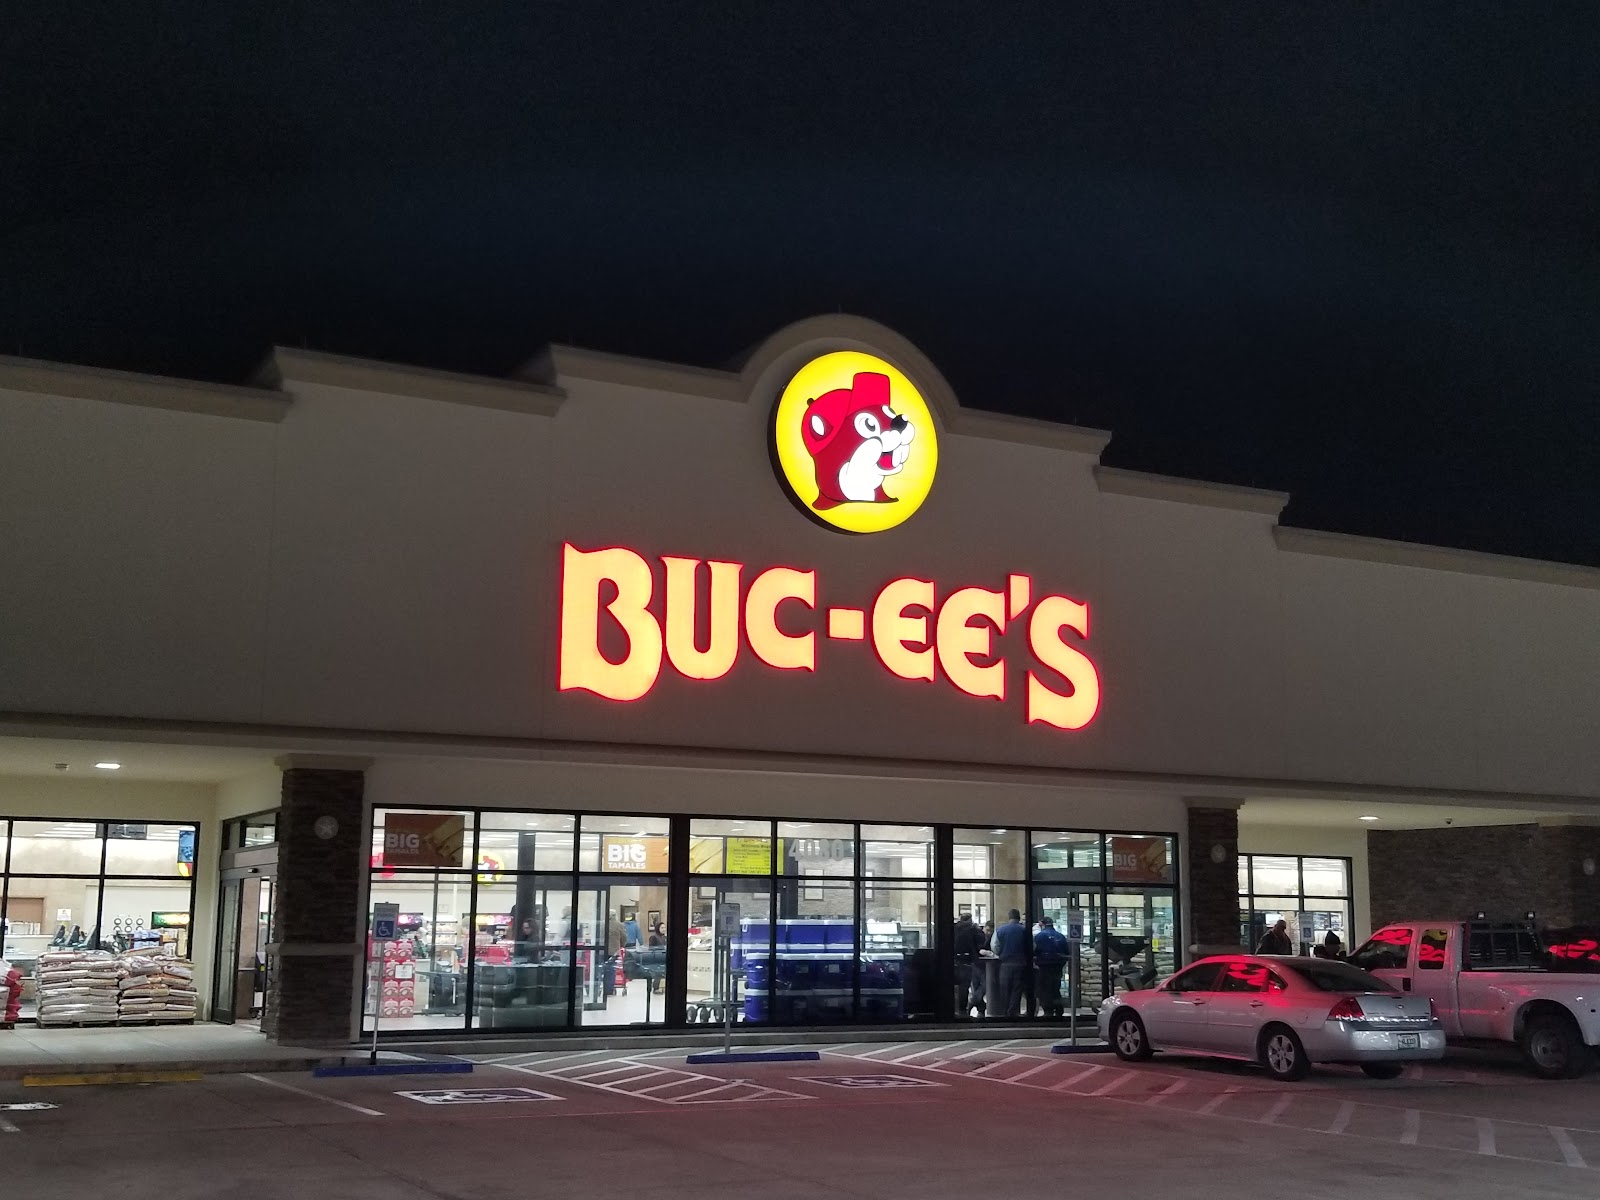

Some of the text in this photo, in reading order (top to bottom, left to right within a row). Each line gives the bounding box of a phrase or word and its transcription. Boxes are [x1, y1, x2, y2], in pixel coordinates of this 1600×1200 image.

[557, 541, 1101, 731] BUC-EE'S
[386, 833, 420, 849] BIG
[608, 843, 647, 863] BIG
[1114, 853, 1137, 867] BIG
[608, 862, 647, 870] TAMALES
